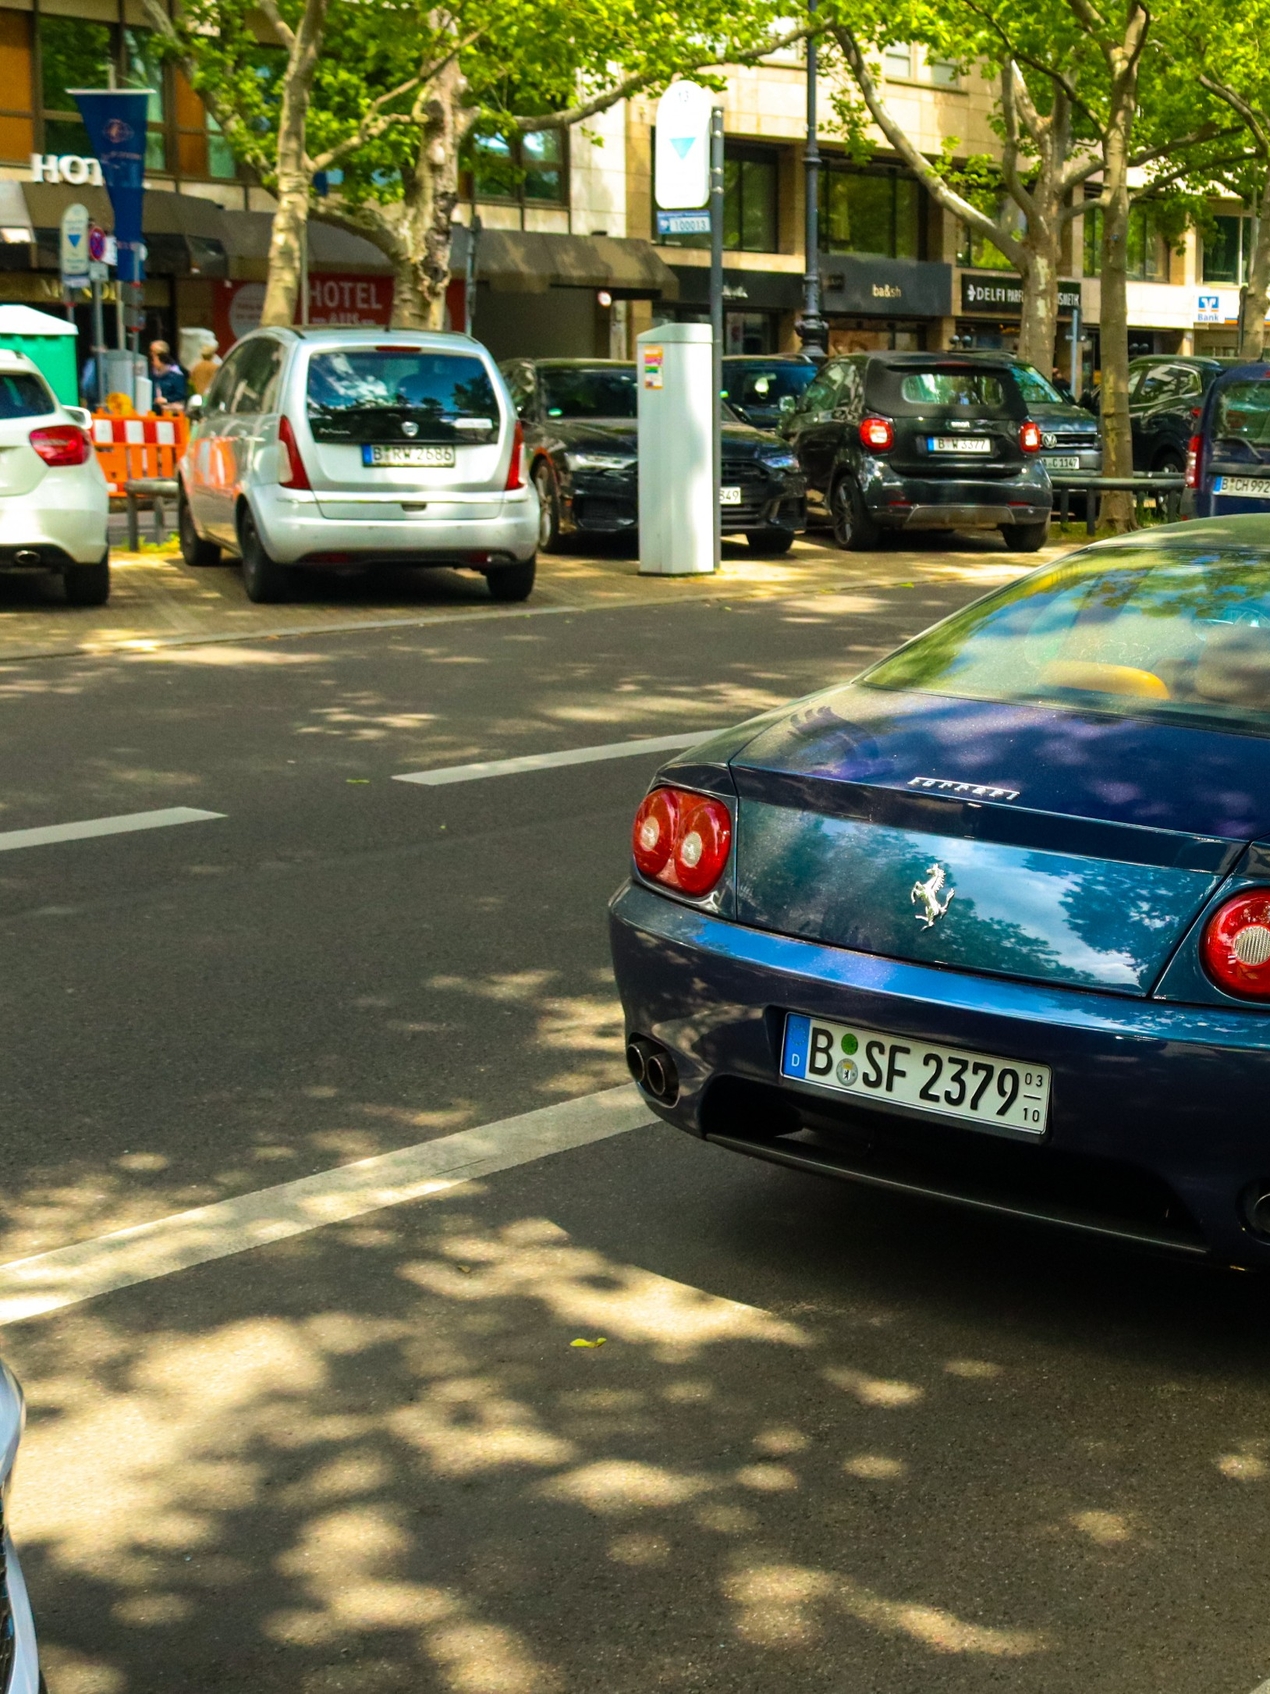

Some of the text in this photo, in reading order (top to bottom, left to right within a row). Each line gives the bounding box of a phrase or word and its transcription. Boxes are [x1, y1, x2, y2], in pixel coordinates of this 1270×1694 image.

[30, 153, 104, 185] HOT
[309, 280, 383, 310] HOTEL
[872, 283, 902, 298] ba&sh
[976, 286, 1006, 302] DELFI
[1197, 313, 1219, 322] Bank
[961, 438, 986, 451] 3377
[373, 446, 453, 461] B RW 2686
[1221, 478, 1229, 490] B
[1235, 479, 1249, 491] CH
[907, 776, 1021, 801] Ferrari
[790, 1026, 1020, 1117] D B SF 2379
[1024, 1072, 1044, 1087] 03
[1022, 1107, 1041, 1123] 10
